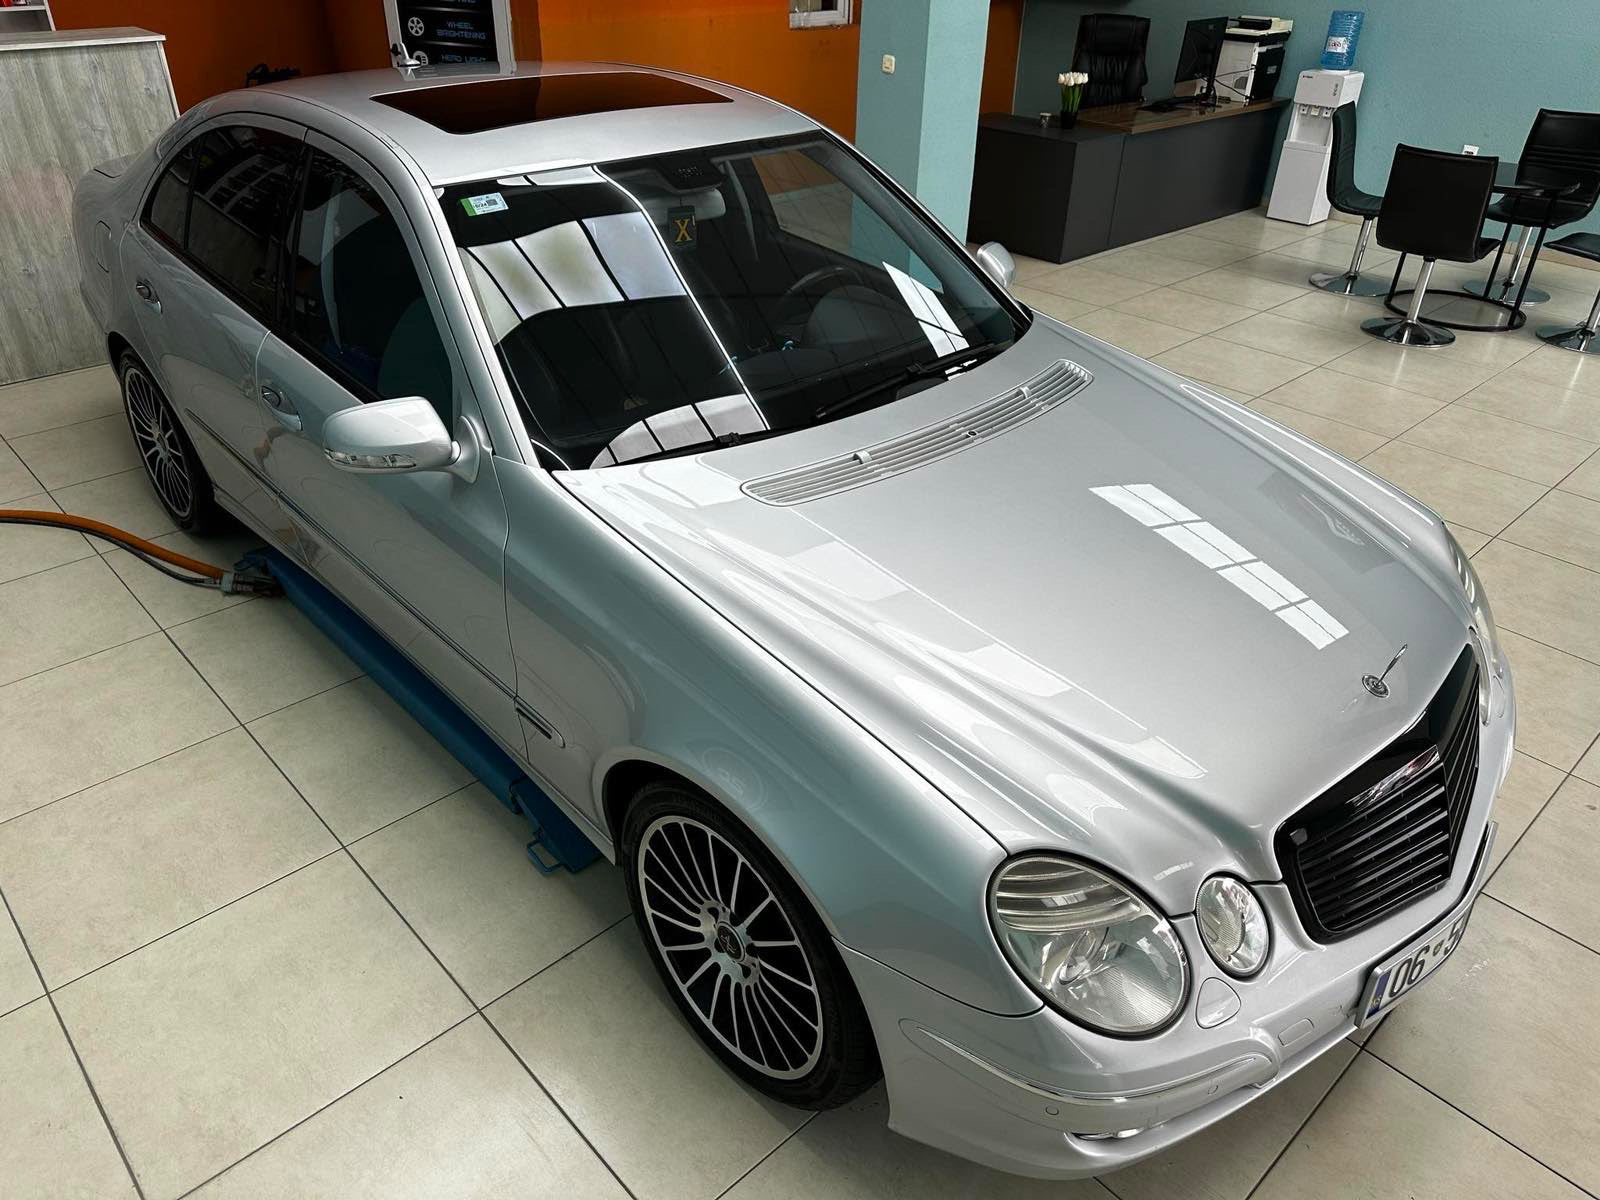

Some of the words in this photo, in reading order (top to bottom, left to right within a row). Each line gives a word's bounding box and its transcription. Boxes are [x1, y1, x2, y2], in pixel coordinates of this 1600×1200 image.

[446, 21, 474, 30] WHEEL
[436, 30, 486, 40] BRIGHTENING
[674, 218, 692, 243] X
[1388, 945, 1430, 998] 06
